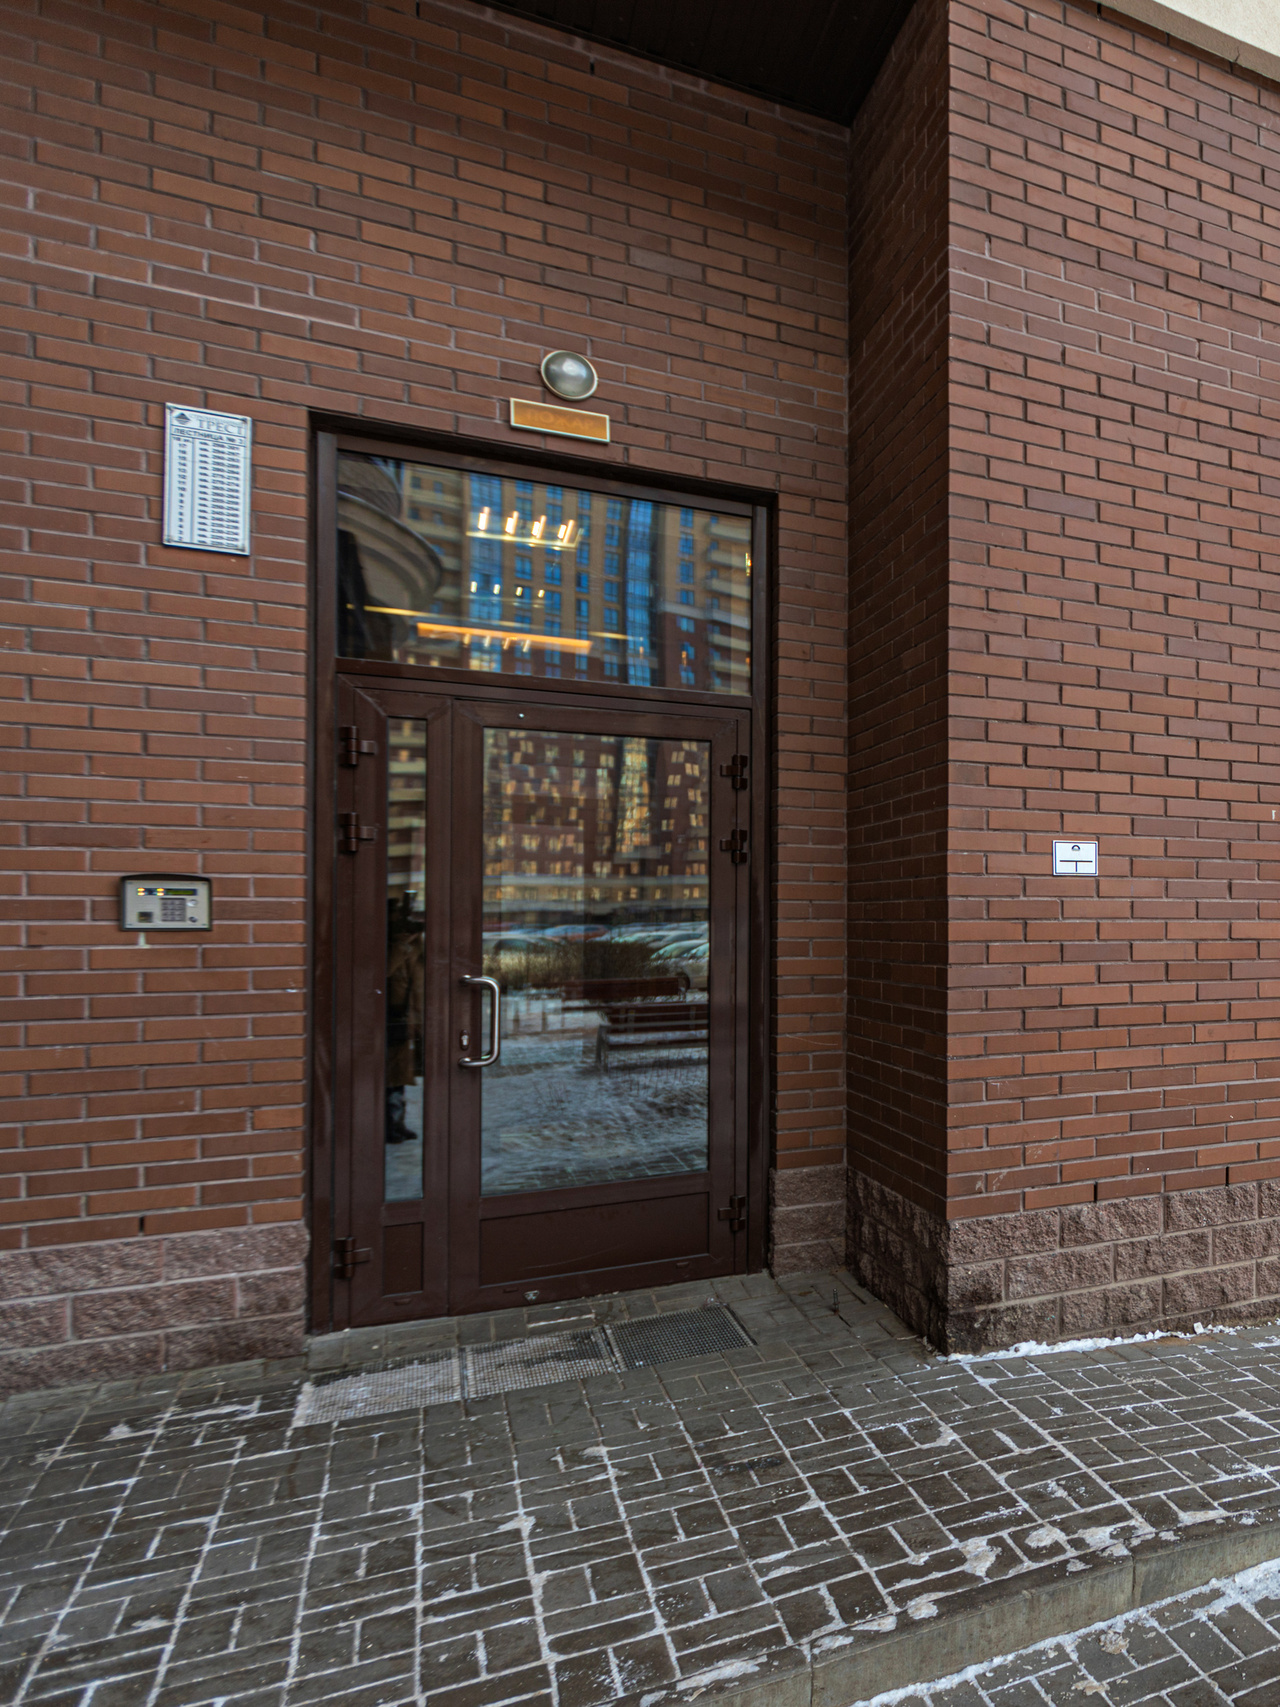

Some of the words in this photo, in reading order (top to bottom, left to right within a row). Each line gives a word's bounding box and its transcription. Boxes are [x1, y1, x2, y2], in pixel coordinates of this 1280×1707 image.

[198, 419, 244, 434] ТРЕСТ
[527, 408, 594, 430] ПОЖАР
[174, 427, 224, 441] ЛЕСТНИЦА
